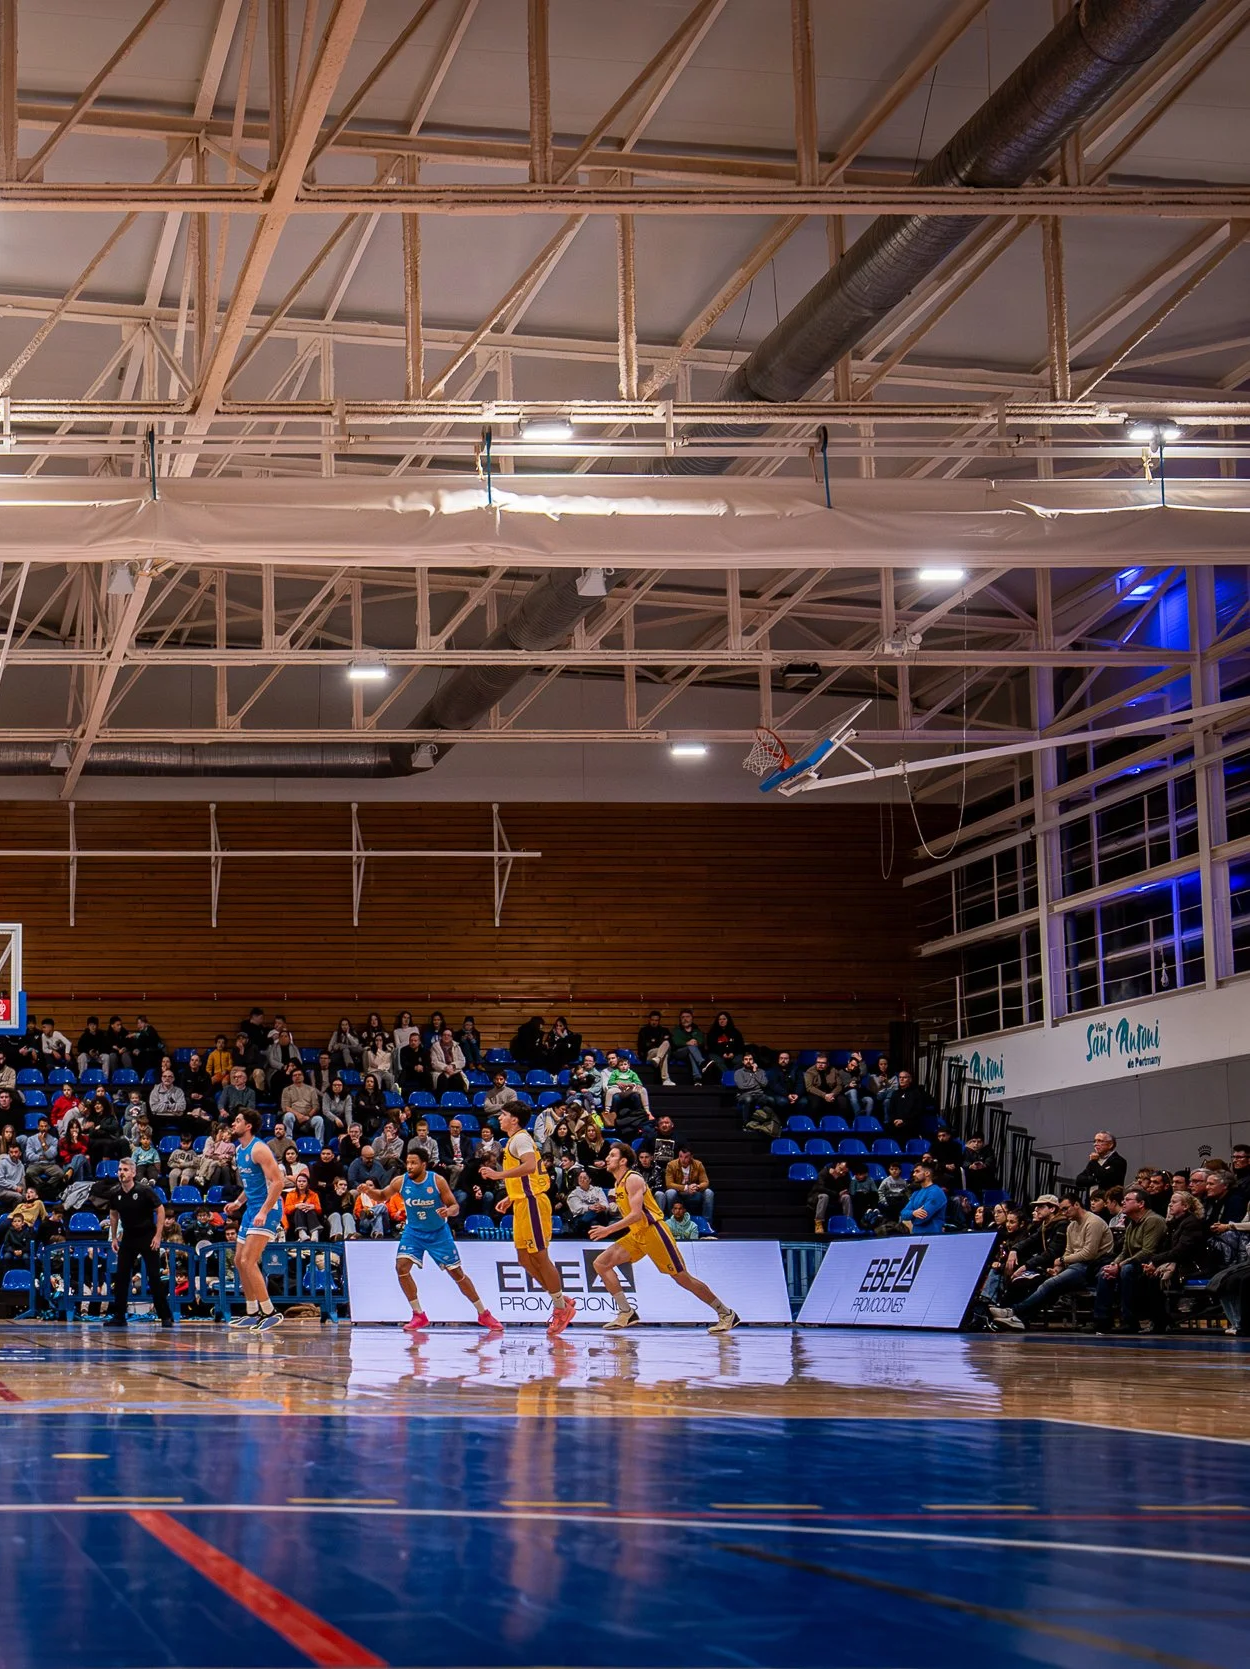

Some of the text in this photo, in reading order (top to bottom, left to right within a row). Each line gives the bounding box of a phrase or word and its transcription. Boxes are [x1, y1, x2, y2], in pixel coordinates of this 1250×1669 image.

[1086, 1017, 1160, 1062] Sant Antoni
[970, 1050, 1004, 1084] Antoni
[1127, 1055, 1162, 1069] de Portmany
[411, 1198, 435, 1206] Class
